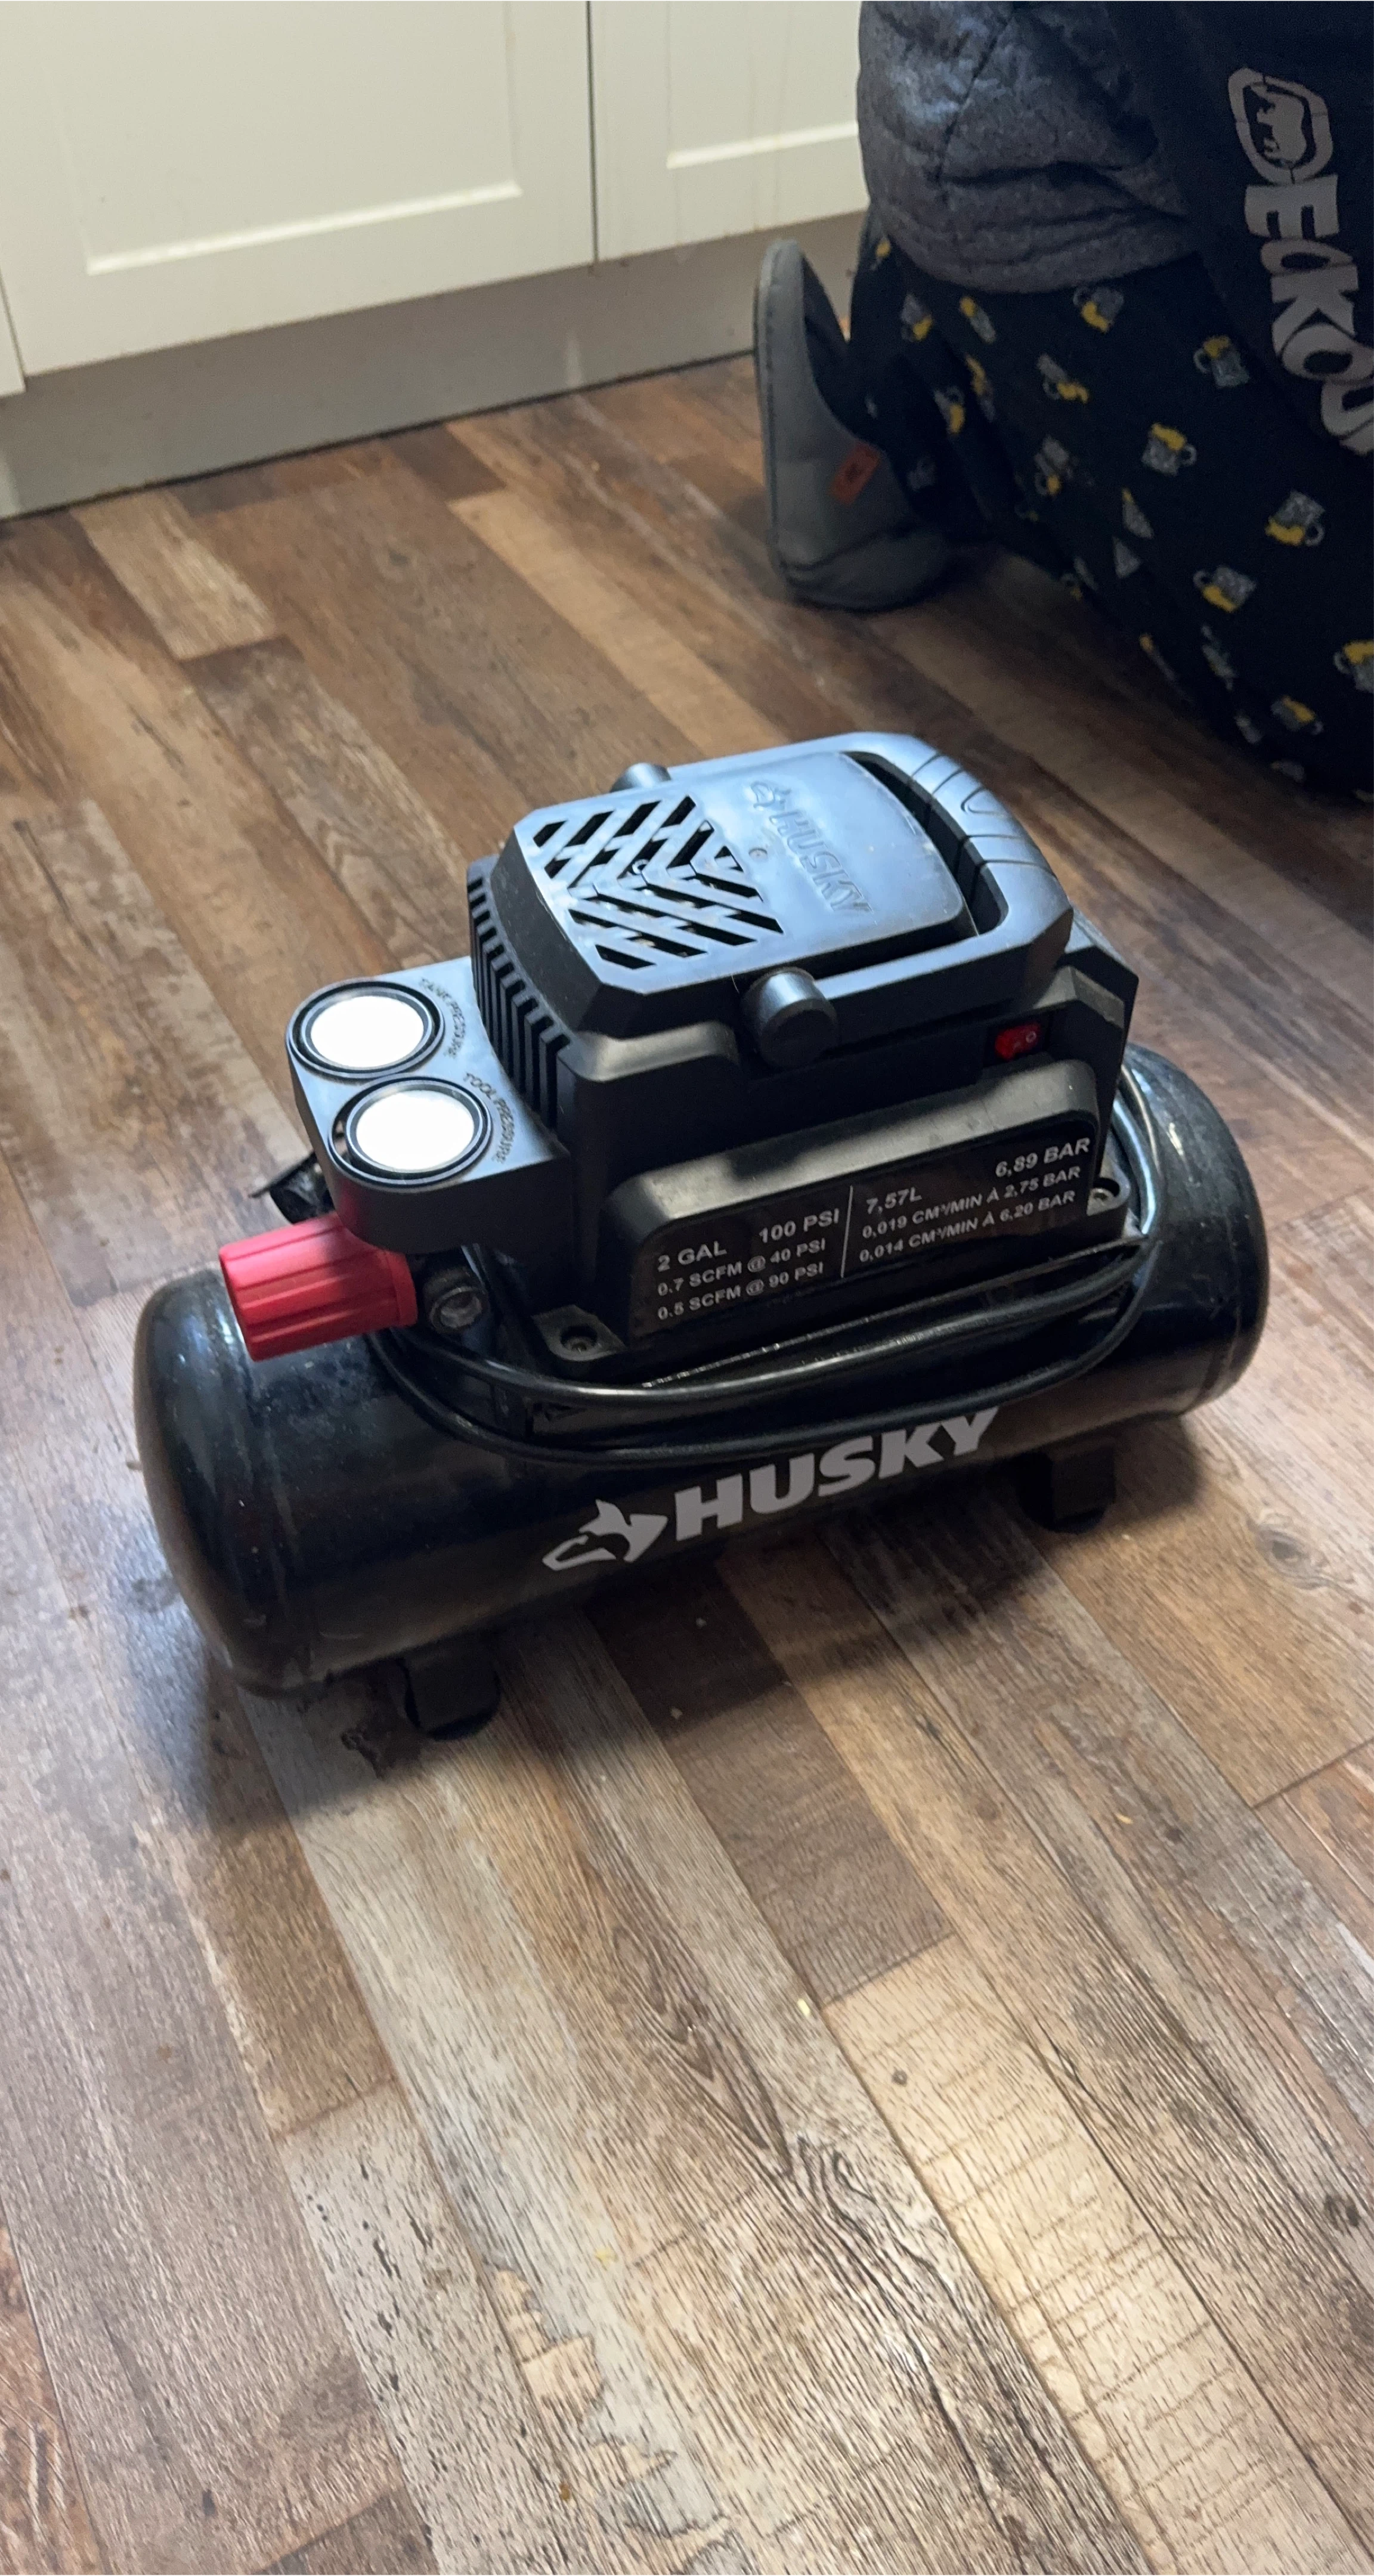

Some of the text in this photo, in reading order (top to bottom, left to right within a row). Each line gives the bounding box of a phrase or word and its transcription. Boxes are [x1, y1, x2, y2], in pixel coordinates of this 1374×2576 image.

[769, 809, 874, 914] HUSKY
[463, 1072, 498, 1099] TOOL
[862, 1215, 908, 1240] 0,019
[1004, 1176, 1039, 1199] 2,75
[1042, 1165, 1081, 1188] BAR
[866, 1137, 1091, 1215] 7,57L 6,89 BAR
[658, 1208, 840, 1272] 2 GAL 100 PSI
[859, 1239, 905, 1263] 0,014
[999, 1202, 1033, 1222] 6,20
[1038, 1190, 1076, 1212] BAR
[658, 1238, 826, 1296] 0.7 SCFM @ 40 PSI
[658, 1261, 824, 1320] 0.5 SCFM @ 90 PSI
[674, 1405, 999, 1541] HUSKY
